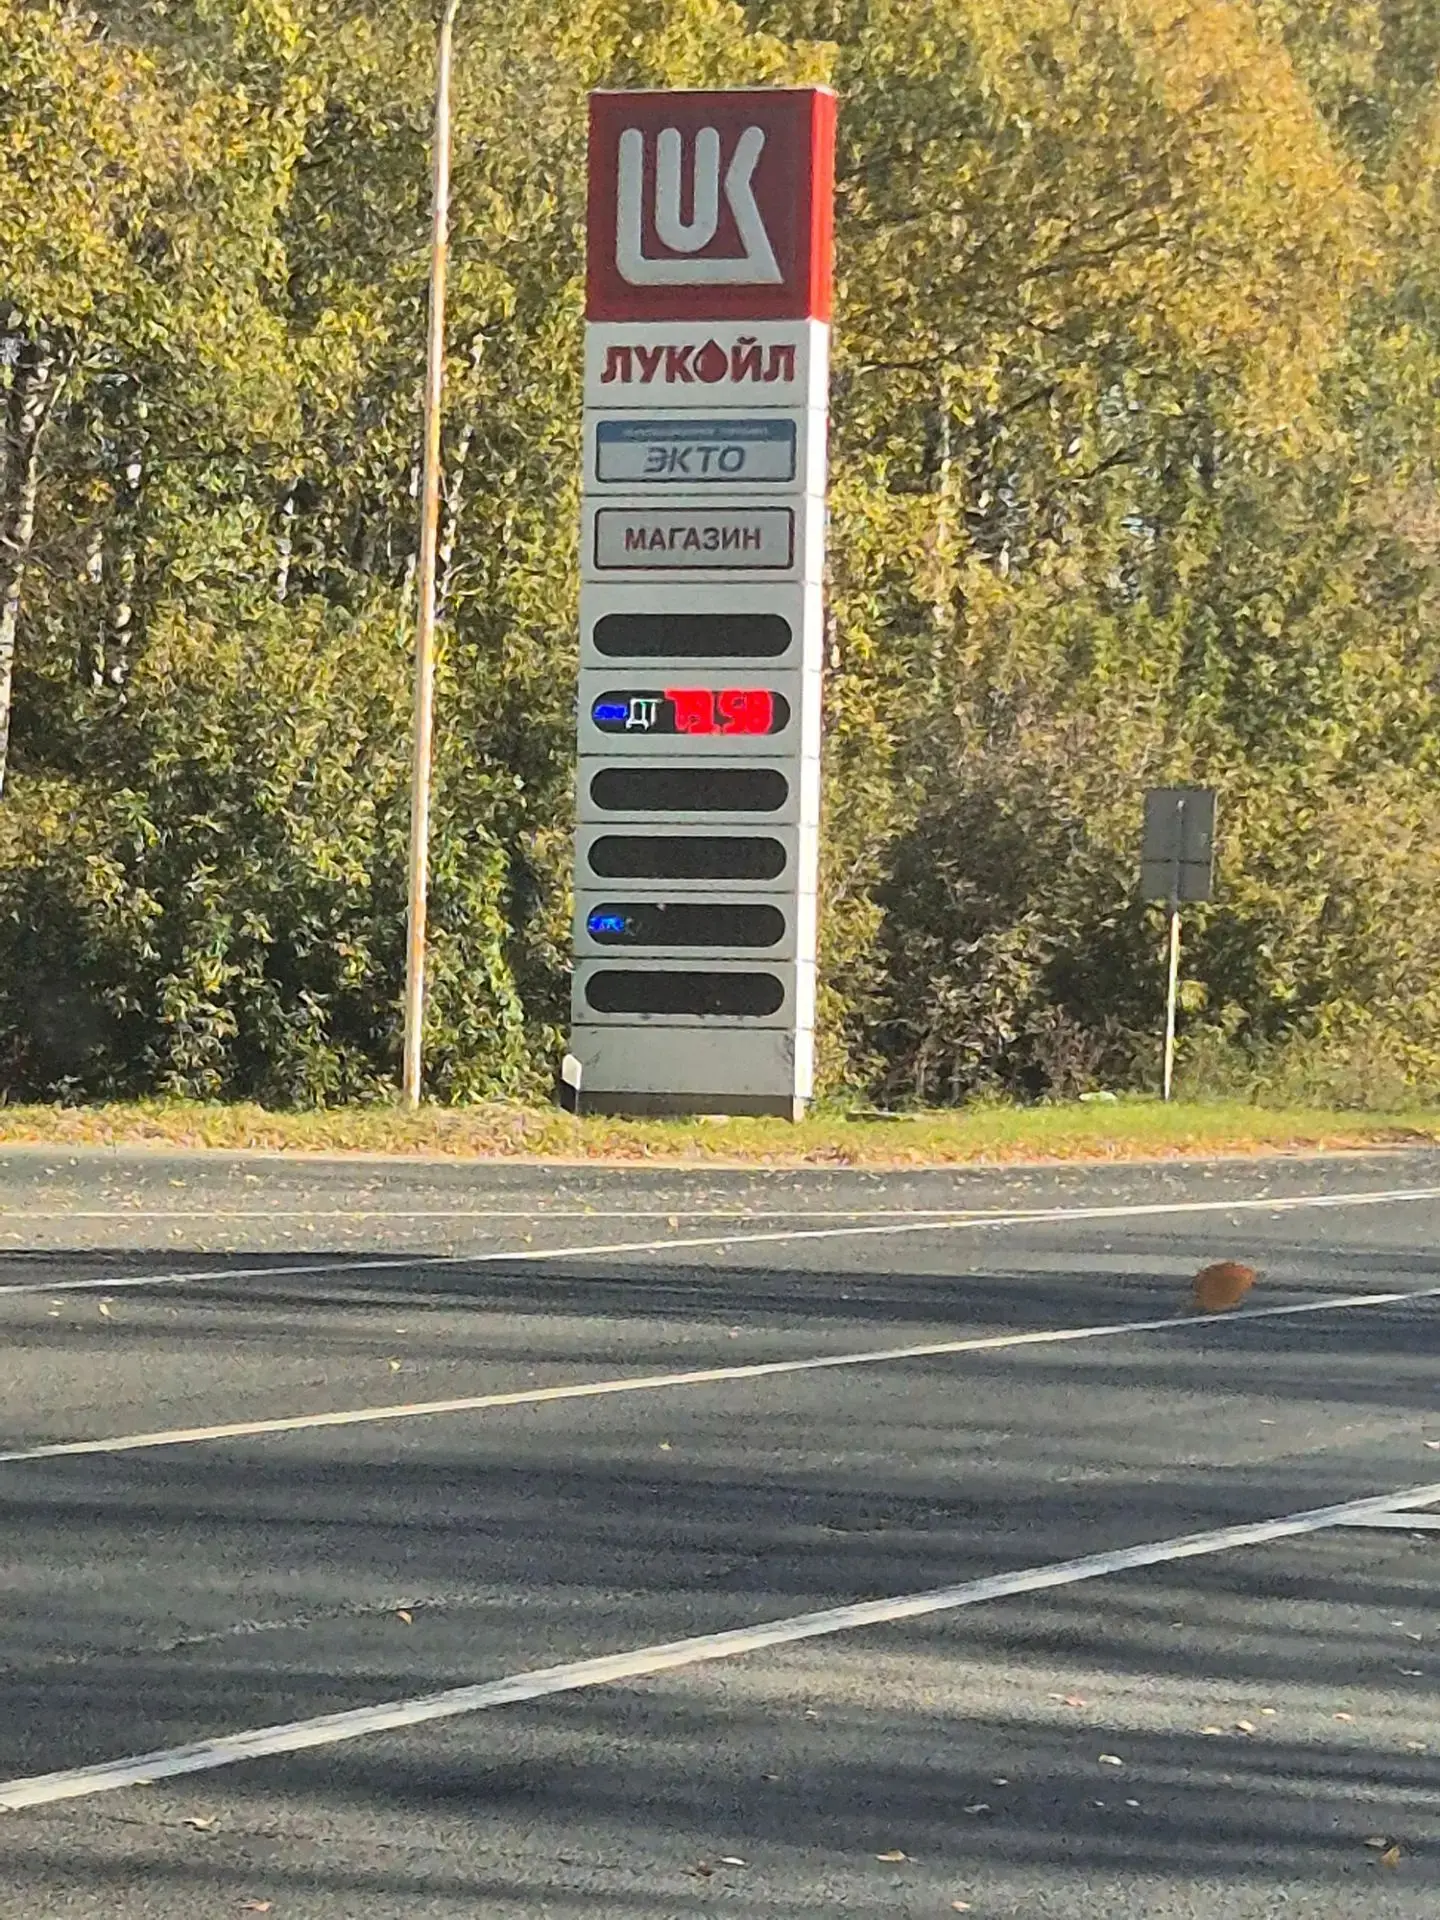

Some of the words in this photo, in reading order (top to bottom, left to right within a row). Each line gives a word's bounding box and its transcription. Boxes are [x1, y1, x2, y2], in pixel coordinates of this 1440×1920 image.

[601, 336, 796, 383] ЛУКОЙЛ
[643, 446, 746, 473] ЭКТО
[625, 527, 761, 551] МАГАЗИН
